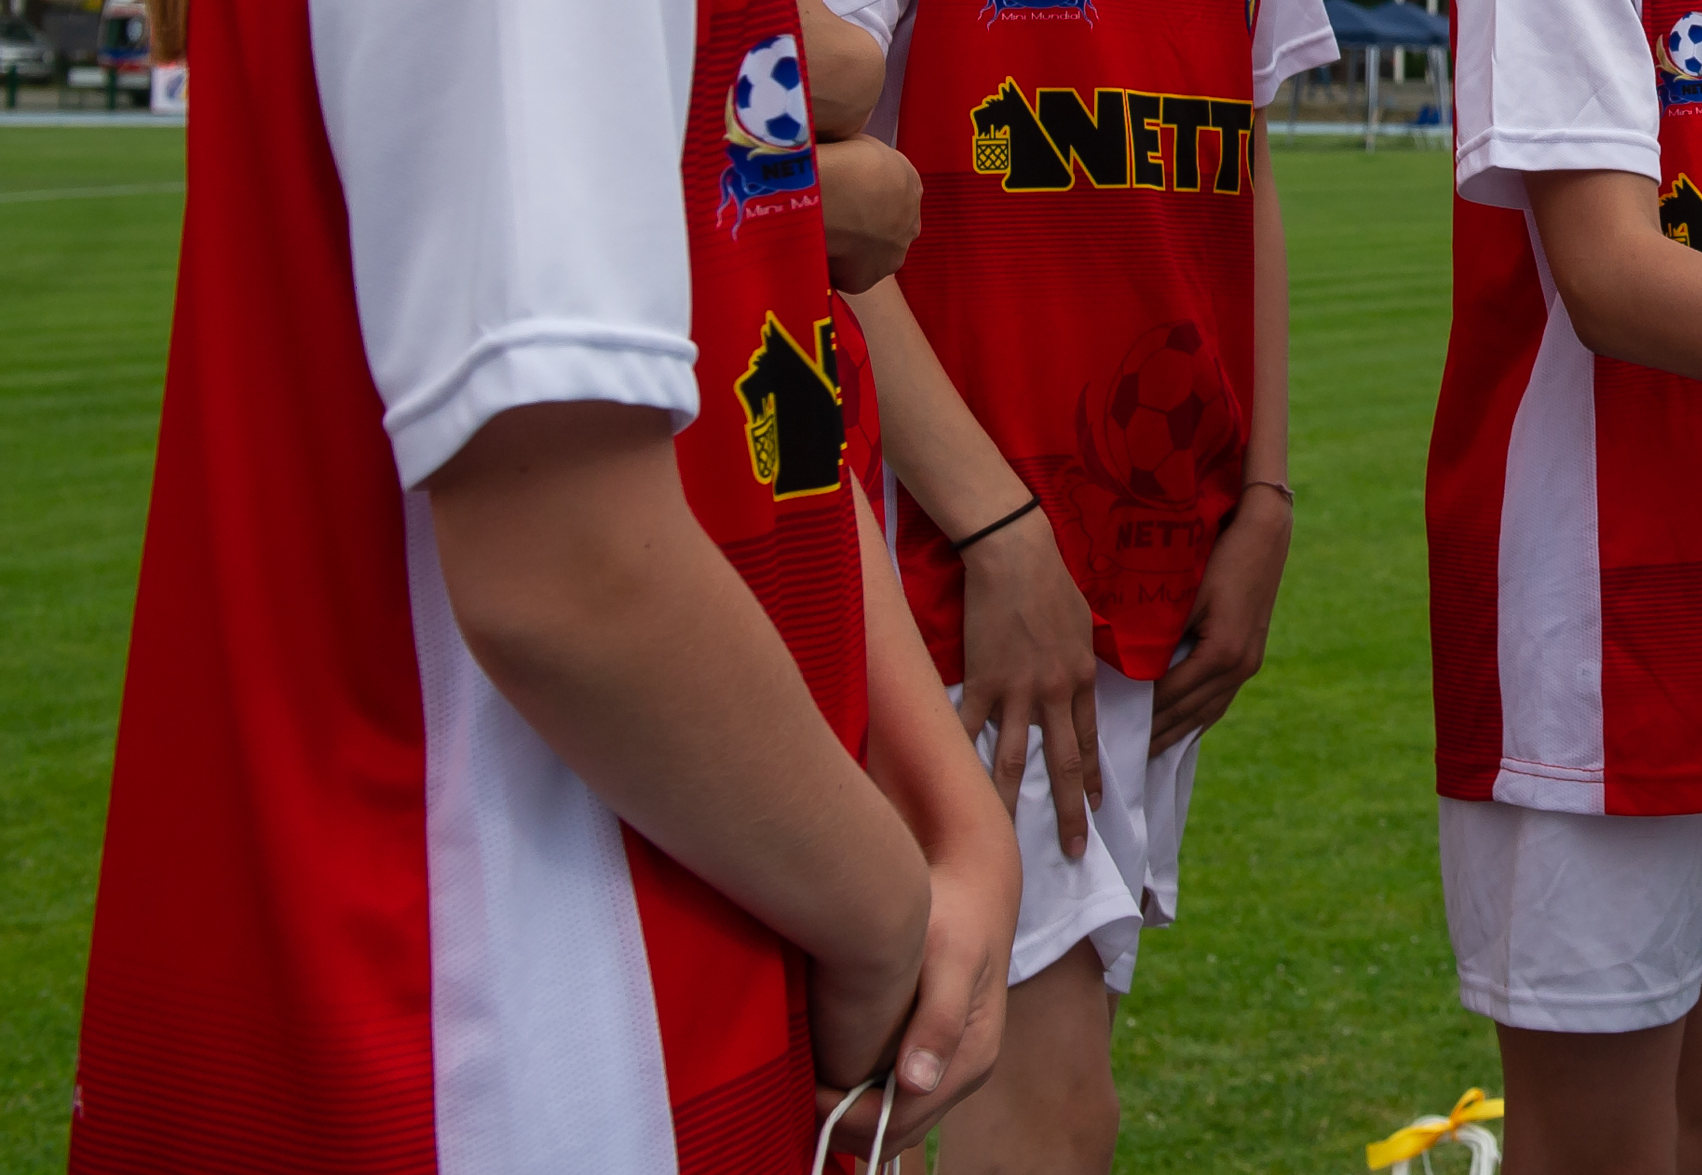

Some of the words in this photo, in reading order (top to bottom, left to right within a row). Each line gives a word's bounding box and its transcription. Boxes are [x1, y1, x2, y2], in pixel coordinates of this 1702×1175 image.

[1001, 12, 1027, 21] Mini
[1031, 10, 1081, 21] Mundial
[1668, 107, 1693, 118] Mini
[1035, 86, 1255, 196] NETT
[745, 203, 784, 218] Mini
